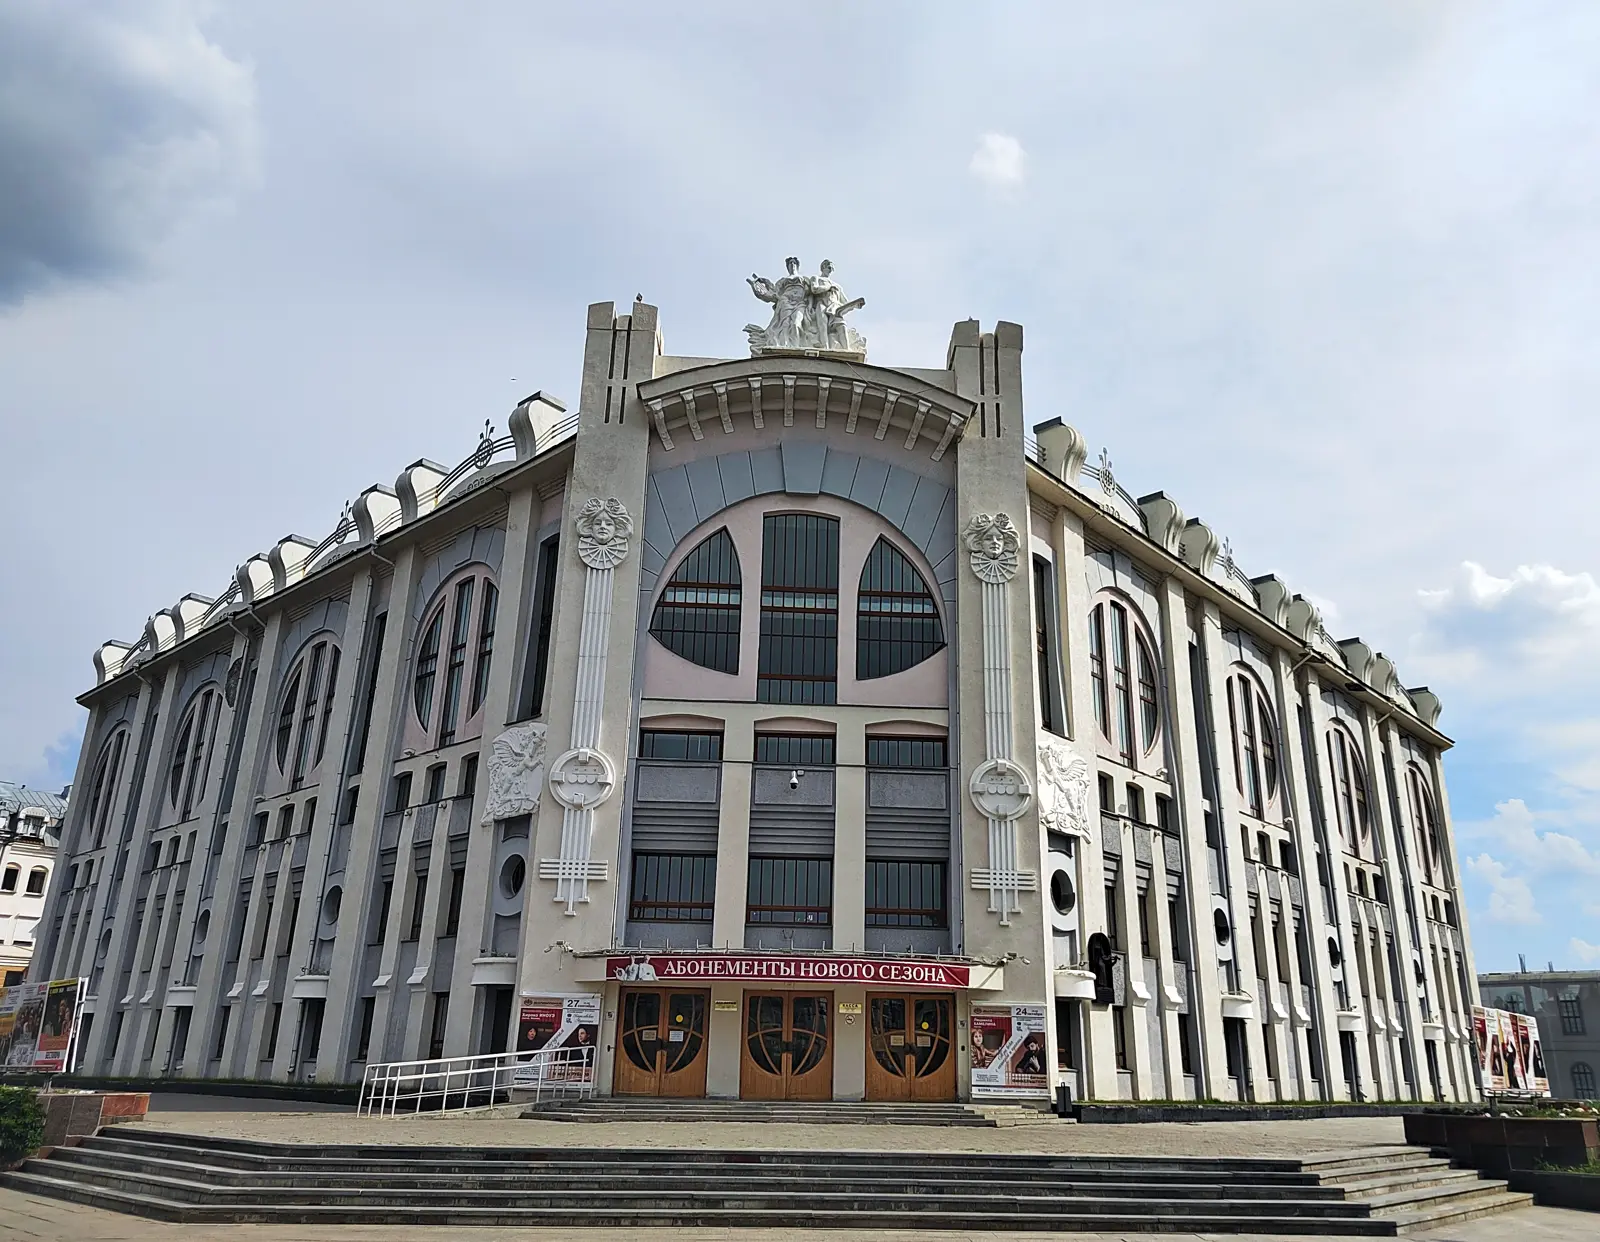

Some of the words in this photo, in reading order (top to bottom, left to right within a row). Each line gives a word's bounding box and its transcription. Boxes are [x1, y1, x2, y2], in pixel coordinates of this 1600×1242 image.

[663, 960, 796, 977] АБОНЕМЕНТЫ
[799, 962, 876, 979] НОВОГО
[878, 965, 947, 983] СЕЗОНА
[567, 999, 580, 1008] 27
[1015, 1007, 1028, 1016] 24
